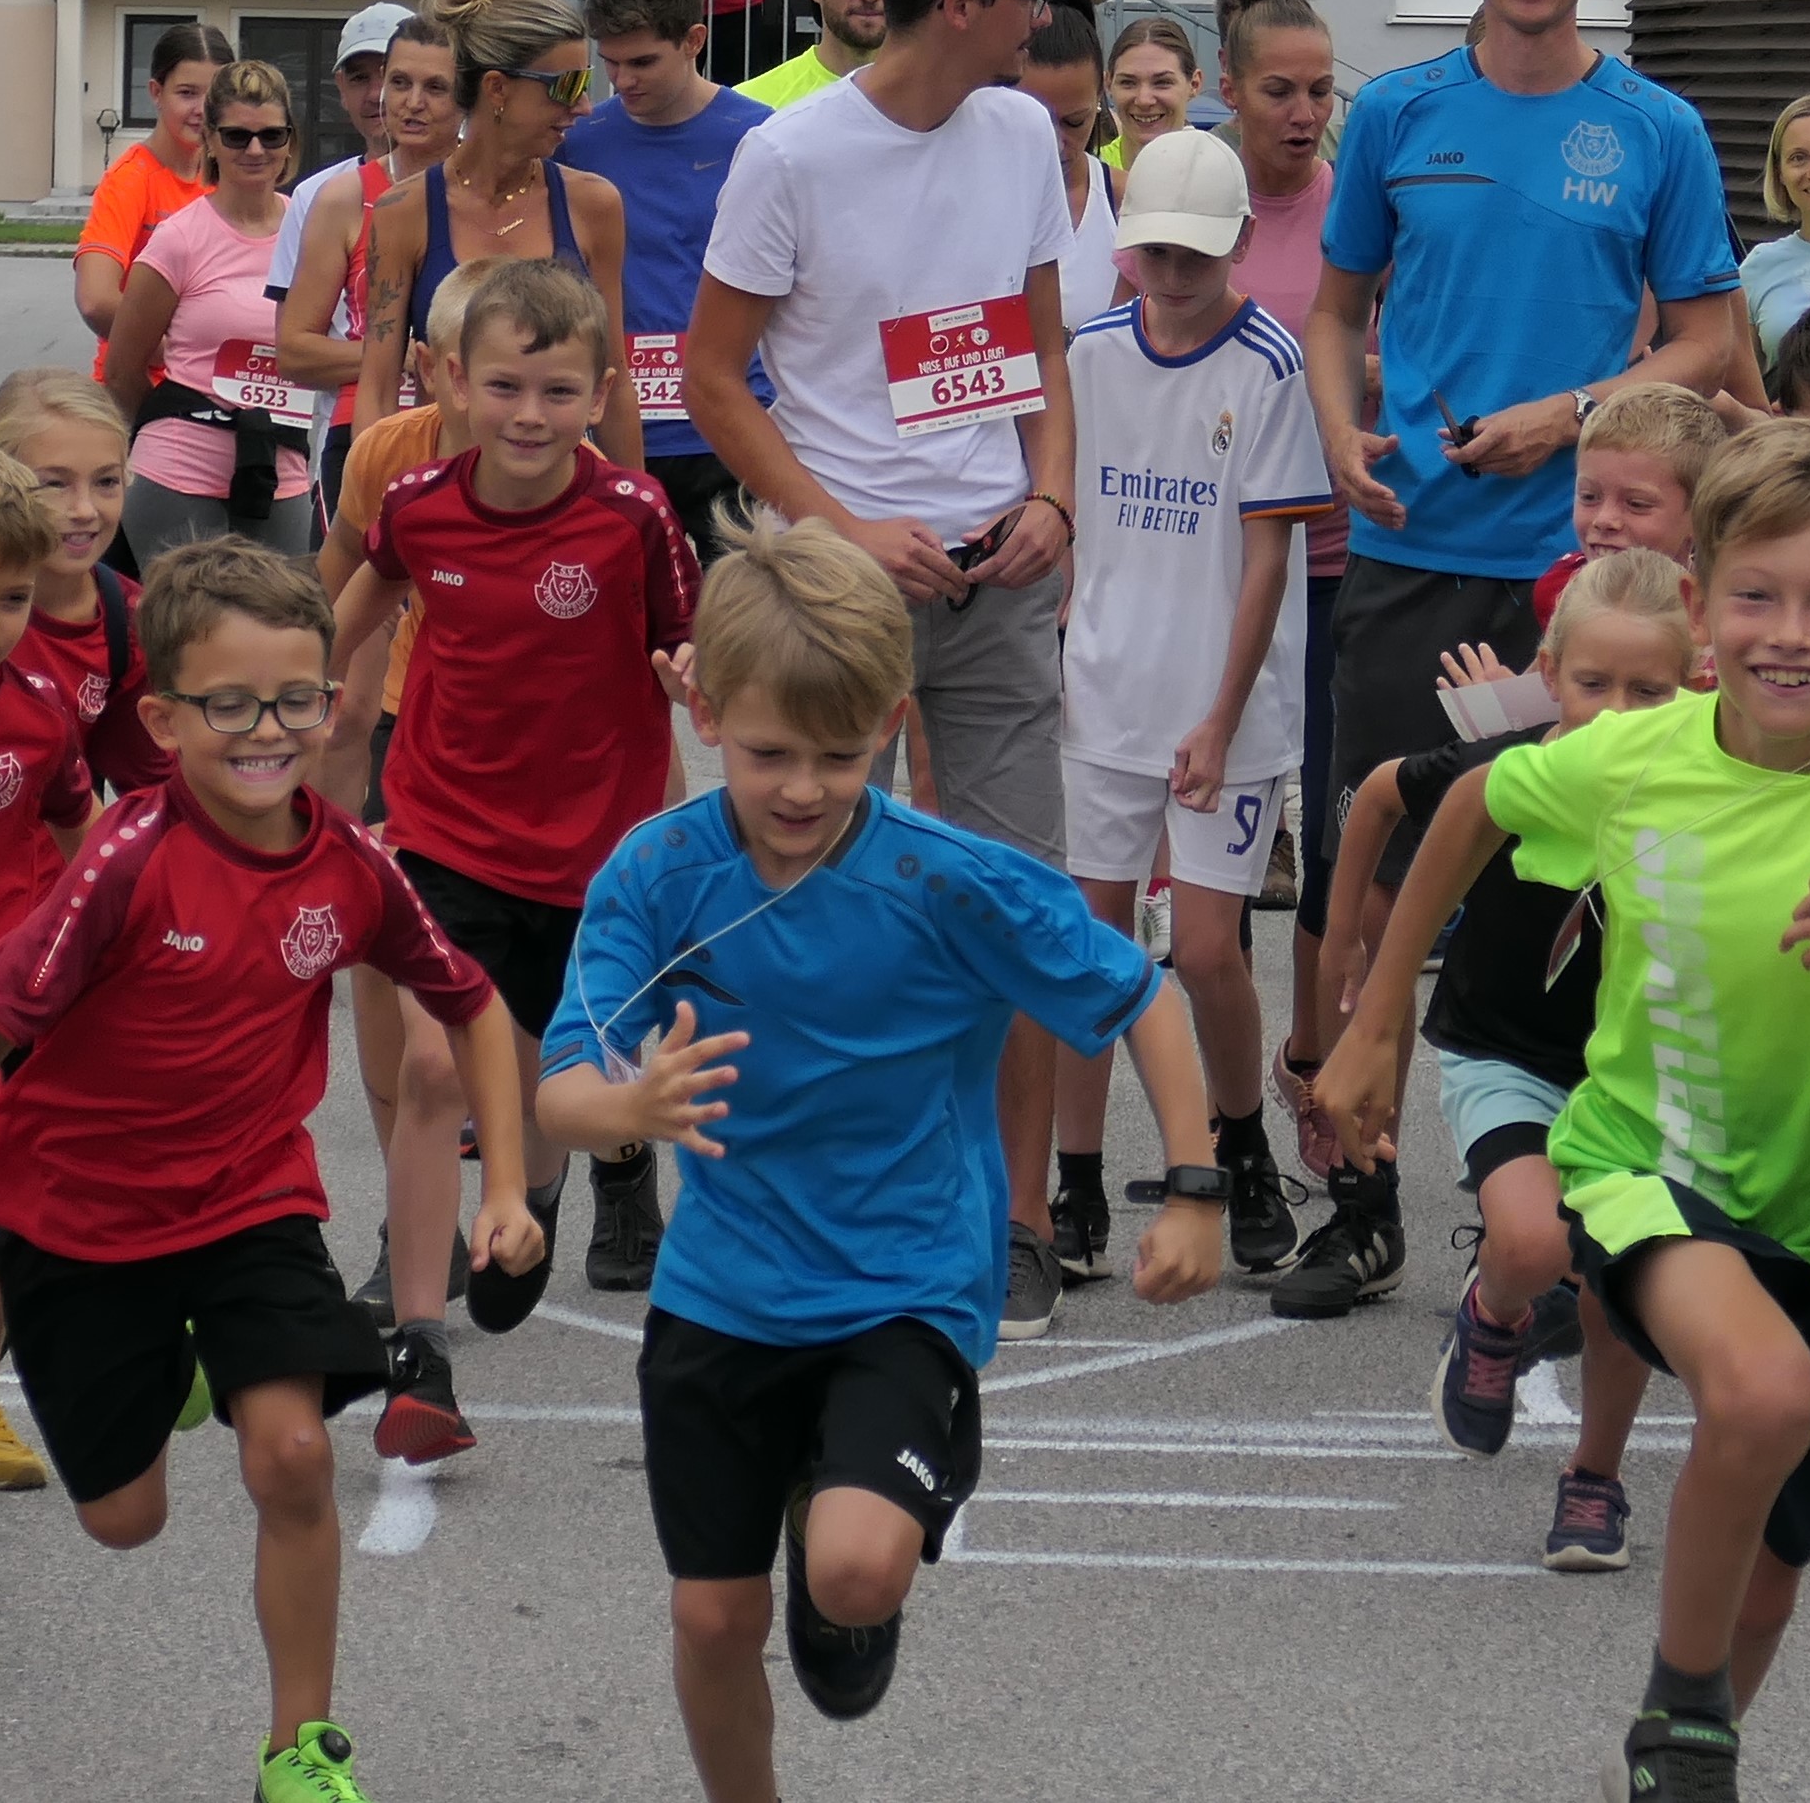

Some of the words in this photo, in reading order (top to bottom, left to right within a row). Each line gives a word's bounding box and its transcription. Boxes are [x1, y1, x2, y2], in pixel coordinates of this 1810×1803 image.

[1426, 151, 1464, 165] JAKO
[1563, 176, 1618, 207] HW
[240, 384, 288, 408] 6523
[634, 381, 681, 402] 542
[931, 366, 1006, 405] 6543
[1100, 466, 1217, 506] Emirates
[1117, 503, 1139, 527] FLY
[1141, 506, 1199, 535] BETTER
[431, 569, 464, 587] JAKO
[1227, 794, 1262, 856] 9
[162, 930, 204, 952] JAKO
[897, 1449, 935, 1492] JAKO
